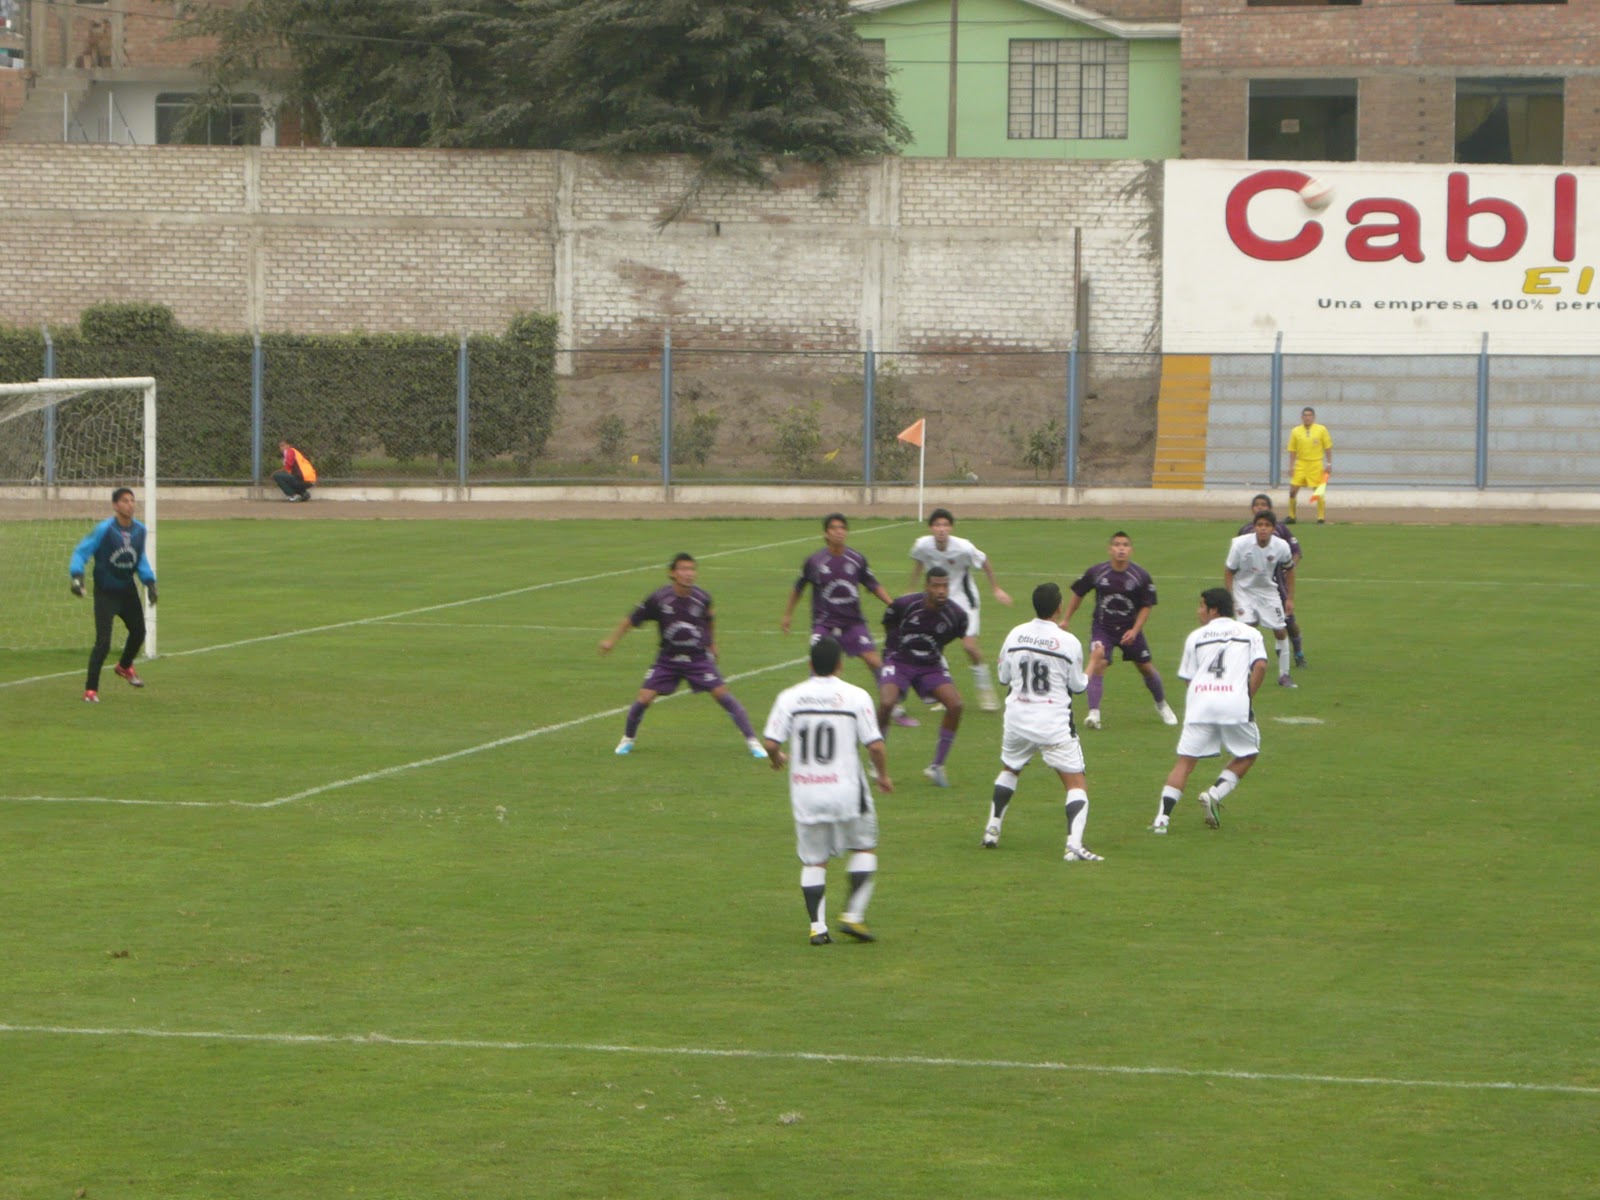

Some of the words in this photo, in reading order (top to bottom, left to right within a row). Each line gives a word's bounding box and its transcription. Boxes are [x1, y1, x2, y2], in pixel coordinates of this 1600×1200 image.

[1225, 168, 1578, 263] Cabl
[1522, 266, 1595, 294] El
[1317, 298, 1362, 309] Una
[1374, 299, 1479, 312] empresa
[1491, 298, 1544, 310] 100%
[1018, 656, 1051, 696] 18
[1207, 649, 1226, 679] 4
[798, 720, 836, 765] 10
